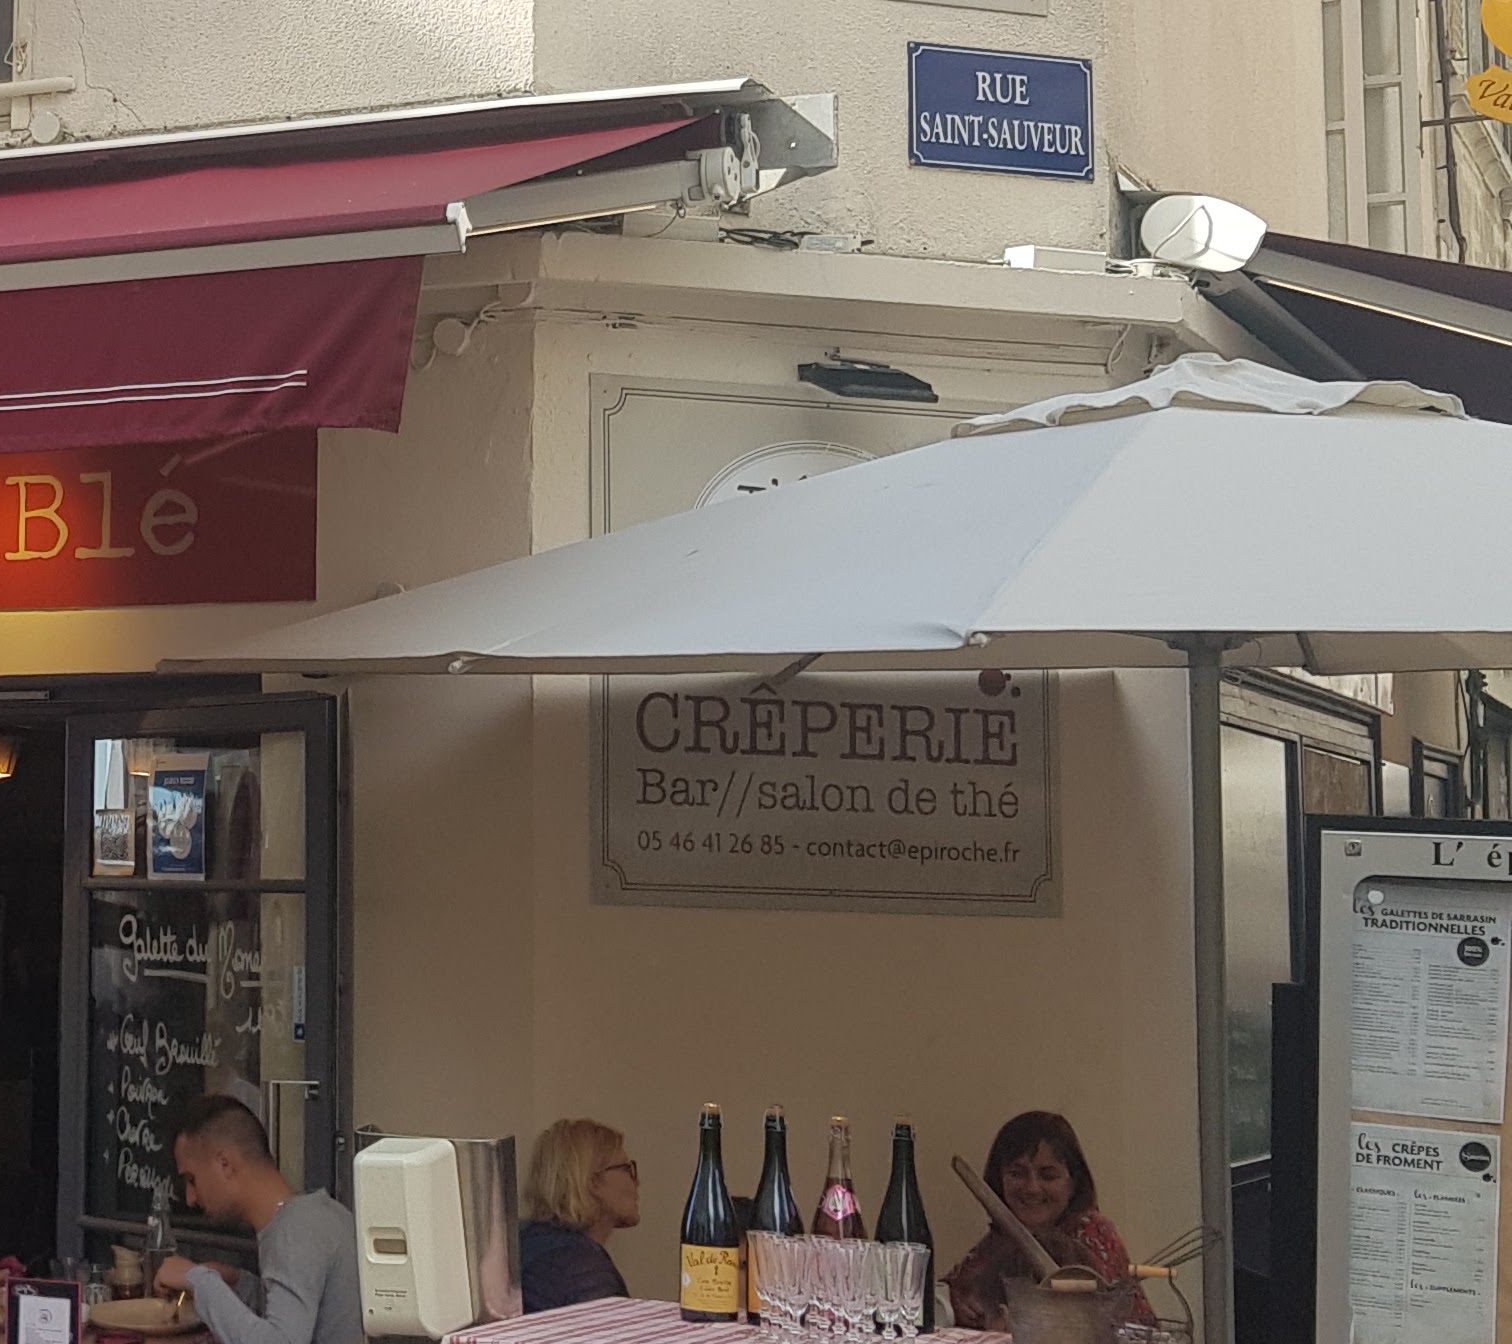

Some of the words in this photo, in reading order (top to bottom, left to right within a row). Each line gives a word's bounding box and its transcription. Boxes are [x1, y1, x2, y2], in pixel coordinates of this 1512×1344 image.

[975, 70, 1031, 106] RUE
[919, 111, 1086, 156] SAINT-SAUVEUR
[3, 452, 200, 562] Blé
[635, 681, 1018, 767] CRÊPERIE
[887, 777, 939, 817] de
[950, 779, 1021, 820] thé
[637, 829, 663, 852] 05
[668, 830, 695, 853] 46
[701, 831, 722, 853] 41
[728, 832, 754, 855] 26
[759, 833, 786, 856] 85
[805, 837, 1021, 866] contact@epiroche.fr
[1362, 916, 1487, 937] TRADITIONNELLES
[1380, 907, 1429, 920] GALETTES
[1431, 911, 1445, 921] DE
[1446, 912, 1497, 925] SARRASIN
[1354, 1152, 1374, 1165] DE
[1375, 1153, 1444, 1172] FROMENT
[1357, 1131, 1382, 1154] les
[1391, 1140, 1440, 1158] CRÊPES
[685, 1250, 706, 1268] Val
[705, 1252, 718, 1265] de
